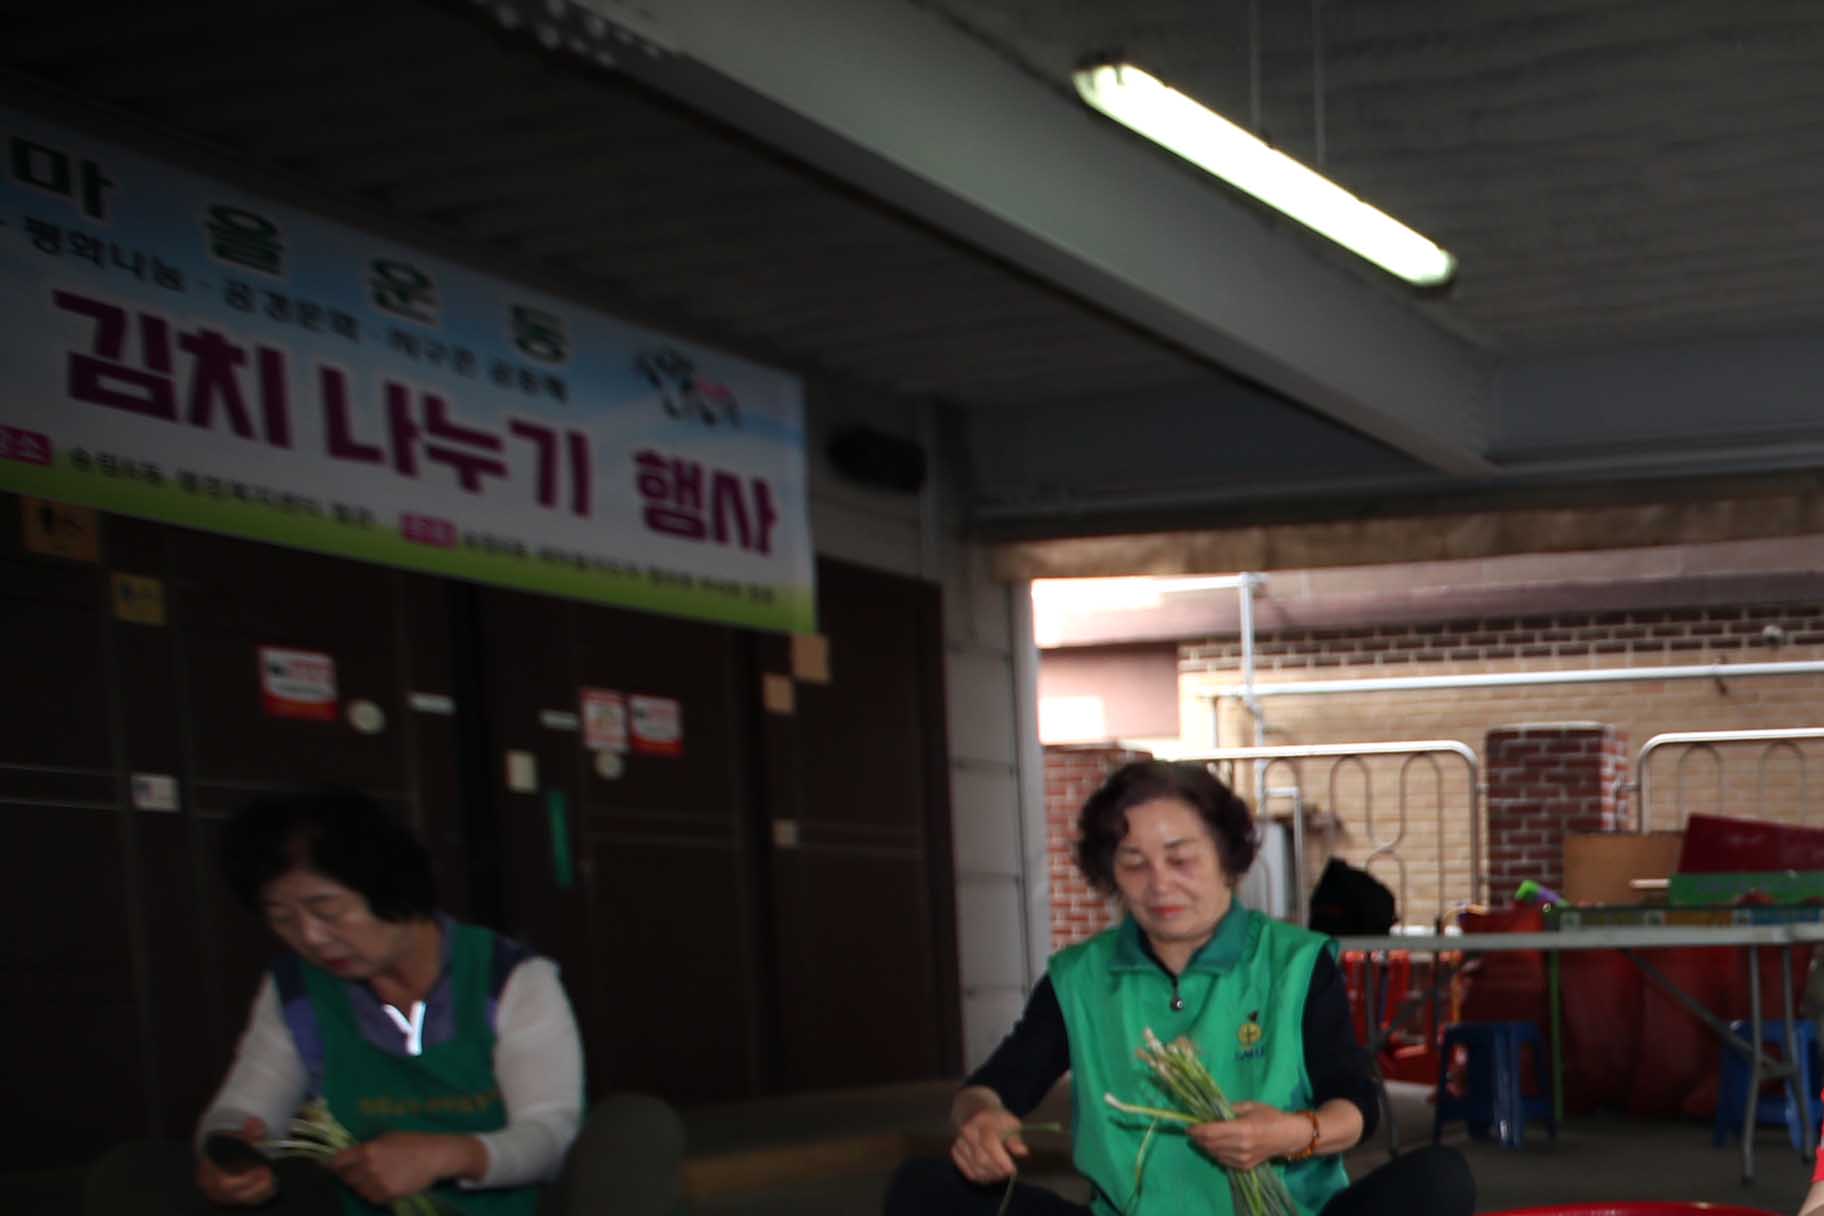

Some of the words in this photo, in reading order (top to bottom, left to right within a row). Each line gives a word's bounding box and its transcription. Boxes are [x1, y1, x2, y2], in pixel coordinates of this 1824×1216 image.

[51, 289, 293, 449] 김치
[317, 366, 593, 520] 나누기
[631, 449, 778, 558] 행사
